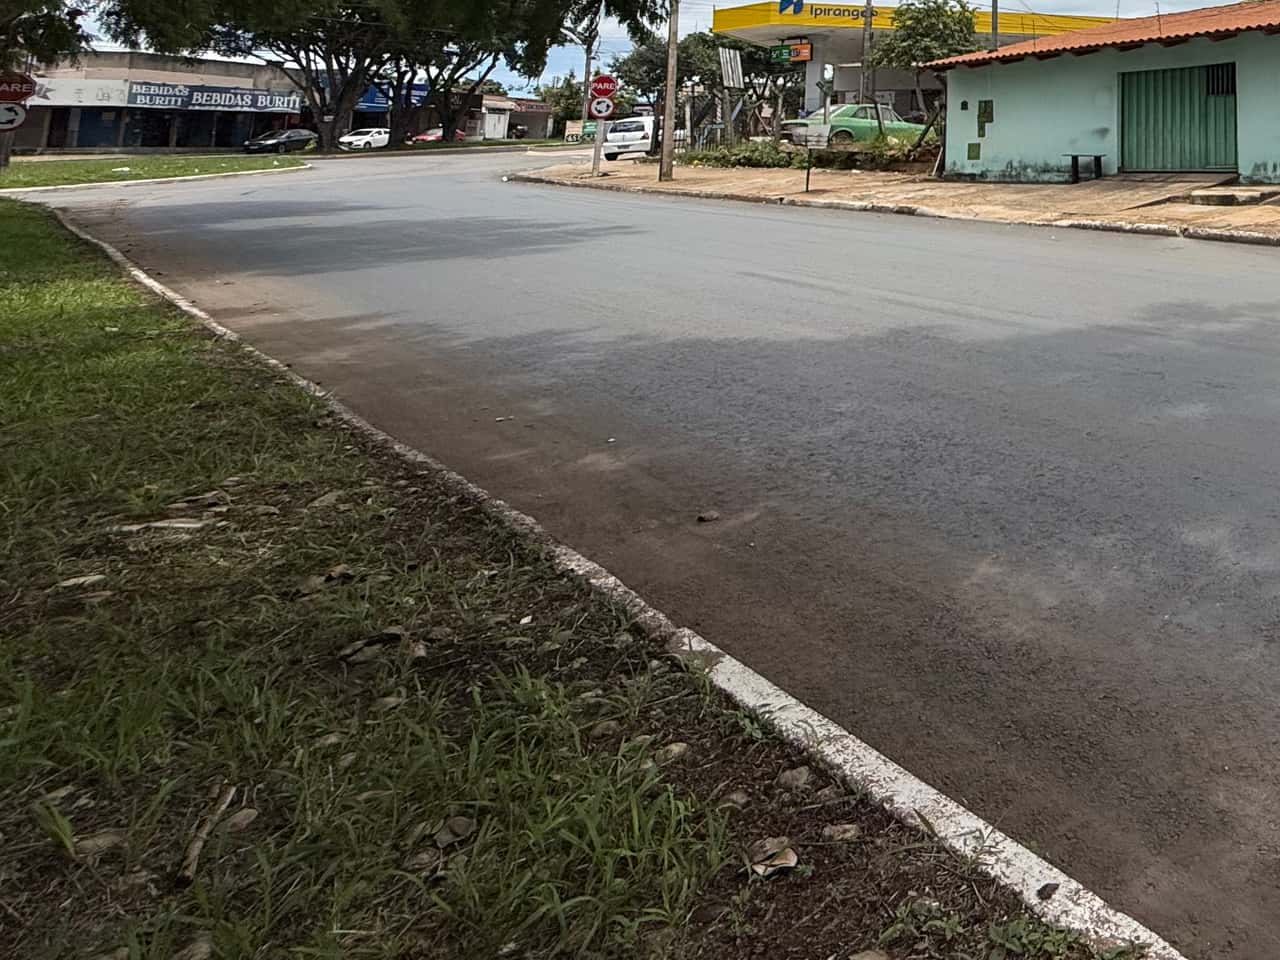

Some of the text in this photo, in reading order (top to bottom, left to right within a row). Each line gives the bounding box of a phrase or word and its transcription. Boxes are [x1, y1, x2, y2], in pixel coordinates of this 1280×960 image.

[0, 83, 33, 93] ARE
[131, 84, 190, 96] BEBIDAS
[592, 82, 616, 90] PARE
[136, 95, 183, 106] BURITI
[191, 91, 300, 108] BEBIDAS BURITI
